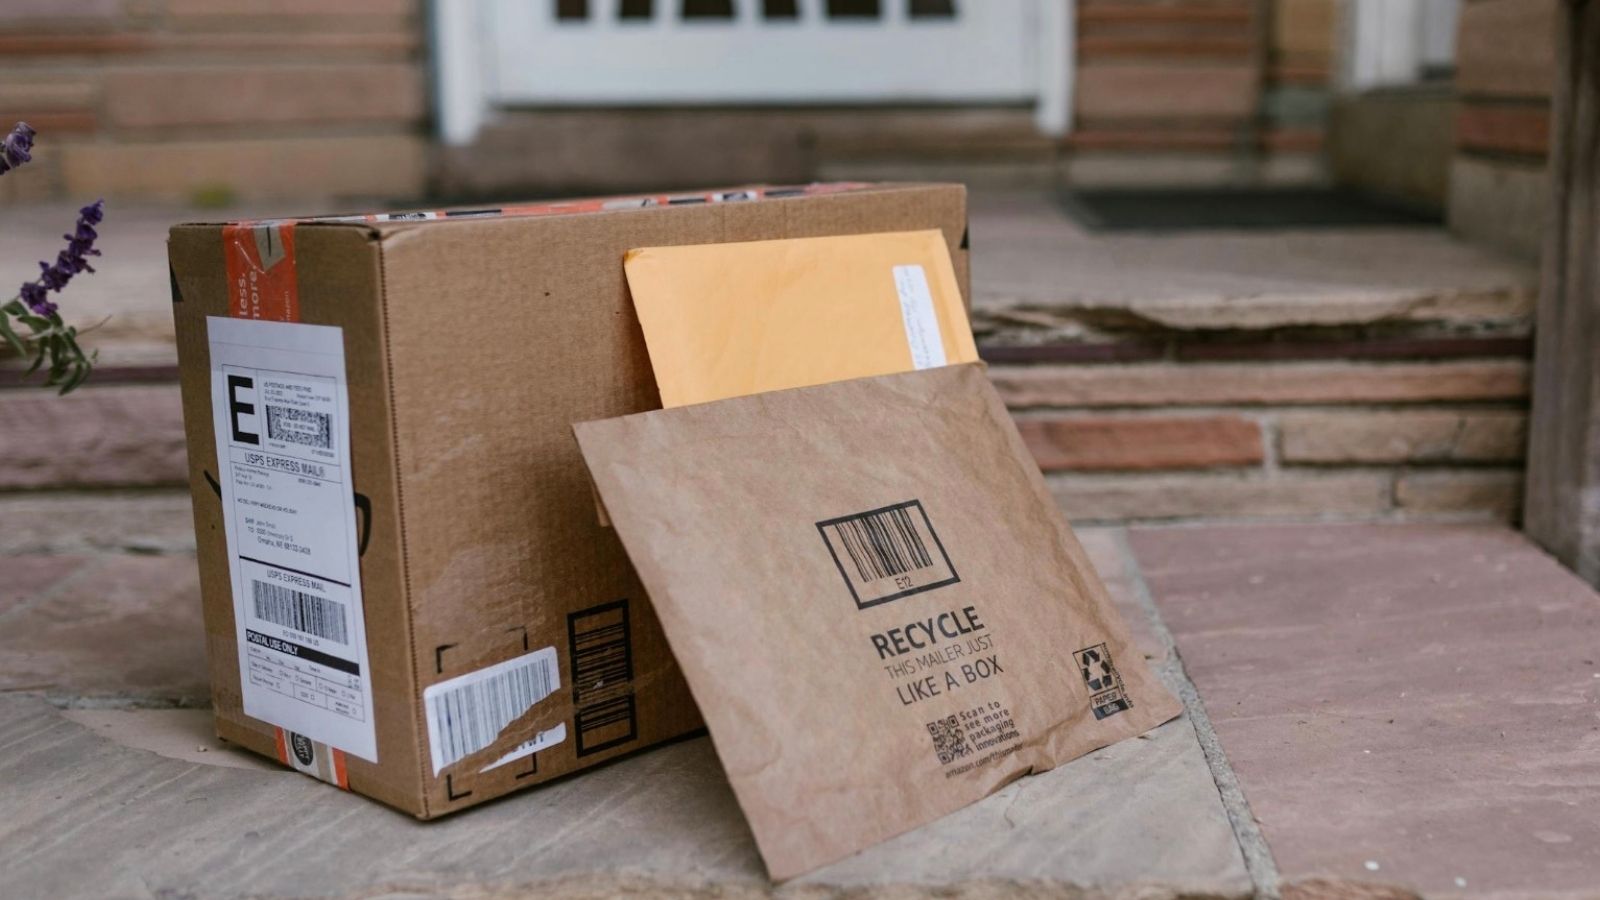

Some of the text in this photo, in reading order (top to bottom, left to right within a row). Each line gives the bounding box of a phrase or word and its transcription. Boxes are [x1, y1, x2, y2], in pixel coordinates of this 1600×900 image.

[227, 374, 260, 446] E
[245, 452, 265, 467] USPS
[266, 456, 300, 473] EXPRESS
[267, 569, 326, 593] USPS EXPRESS MAIL
[895, 575, 913, 590] E12
[246, 630, 270, 647] POSTAL
[269, 638, 283, 650] USE
[282, 642, 299, 656] ONLY
[870, 605, 985, 660] RECYCLE
[884, 633, 995, 680] THIS MAILER JUST
[896, 654, 1004, 706] LIKE A BOX
[959, 700, 1001, 721] Scan to
[964, 708, 1010, 731] see more
[969, 718, 1015, 746] packaging
[975, 729, 1020, 751] innovations
